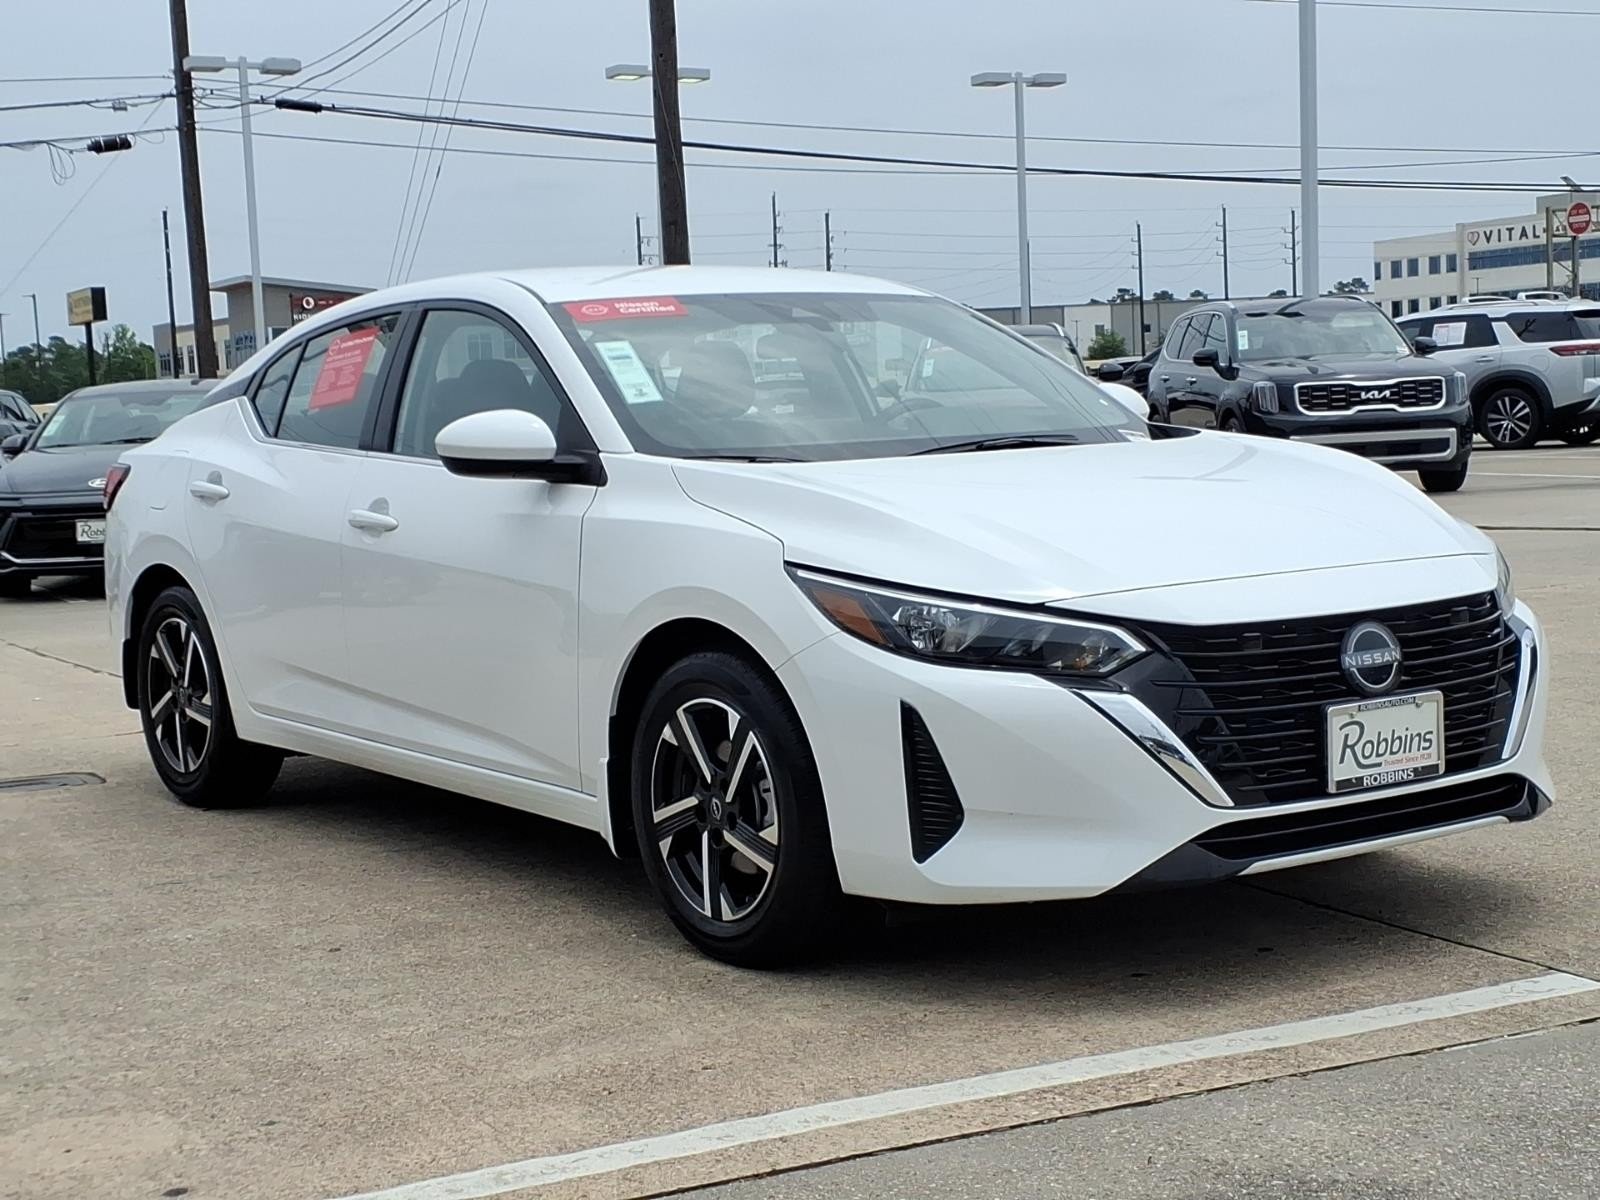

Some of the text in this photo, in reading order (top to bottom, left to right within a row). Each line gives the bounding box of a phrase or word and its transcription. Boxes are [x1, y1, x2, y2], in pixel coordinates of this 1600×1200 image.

[1483, 224, 1540, 244] VITAL
[1344, 650, 1400, 666] NISSAN
[1338, 720, 1434, 769] Robbins
[1363, 768, 1415, 787] ROBBINS
